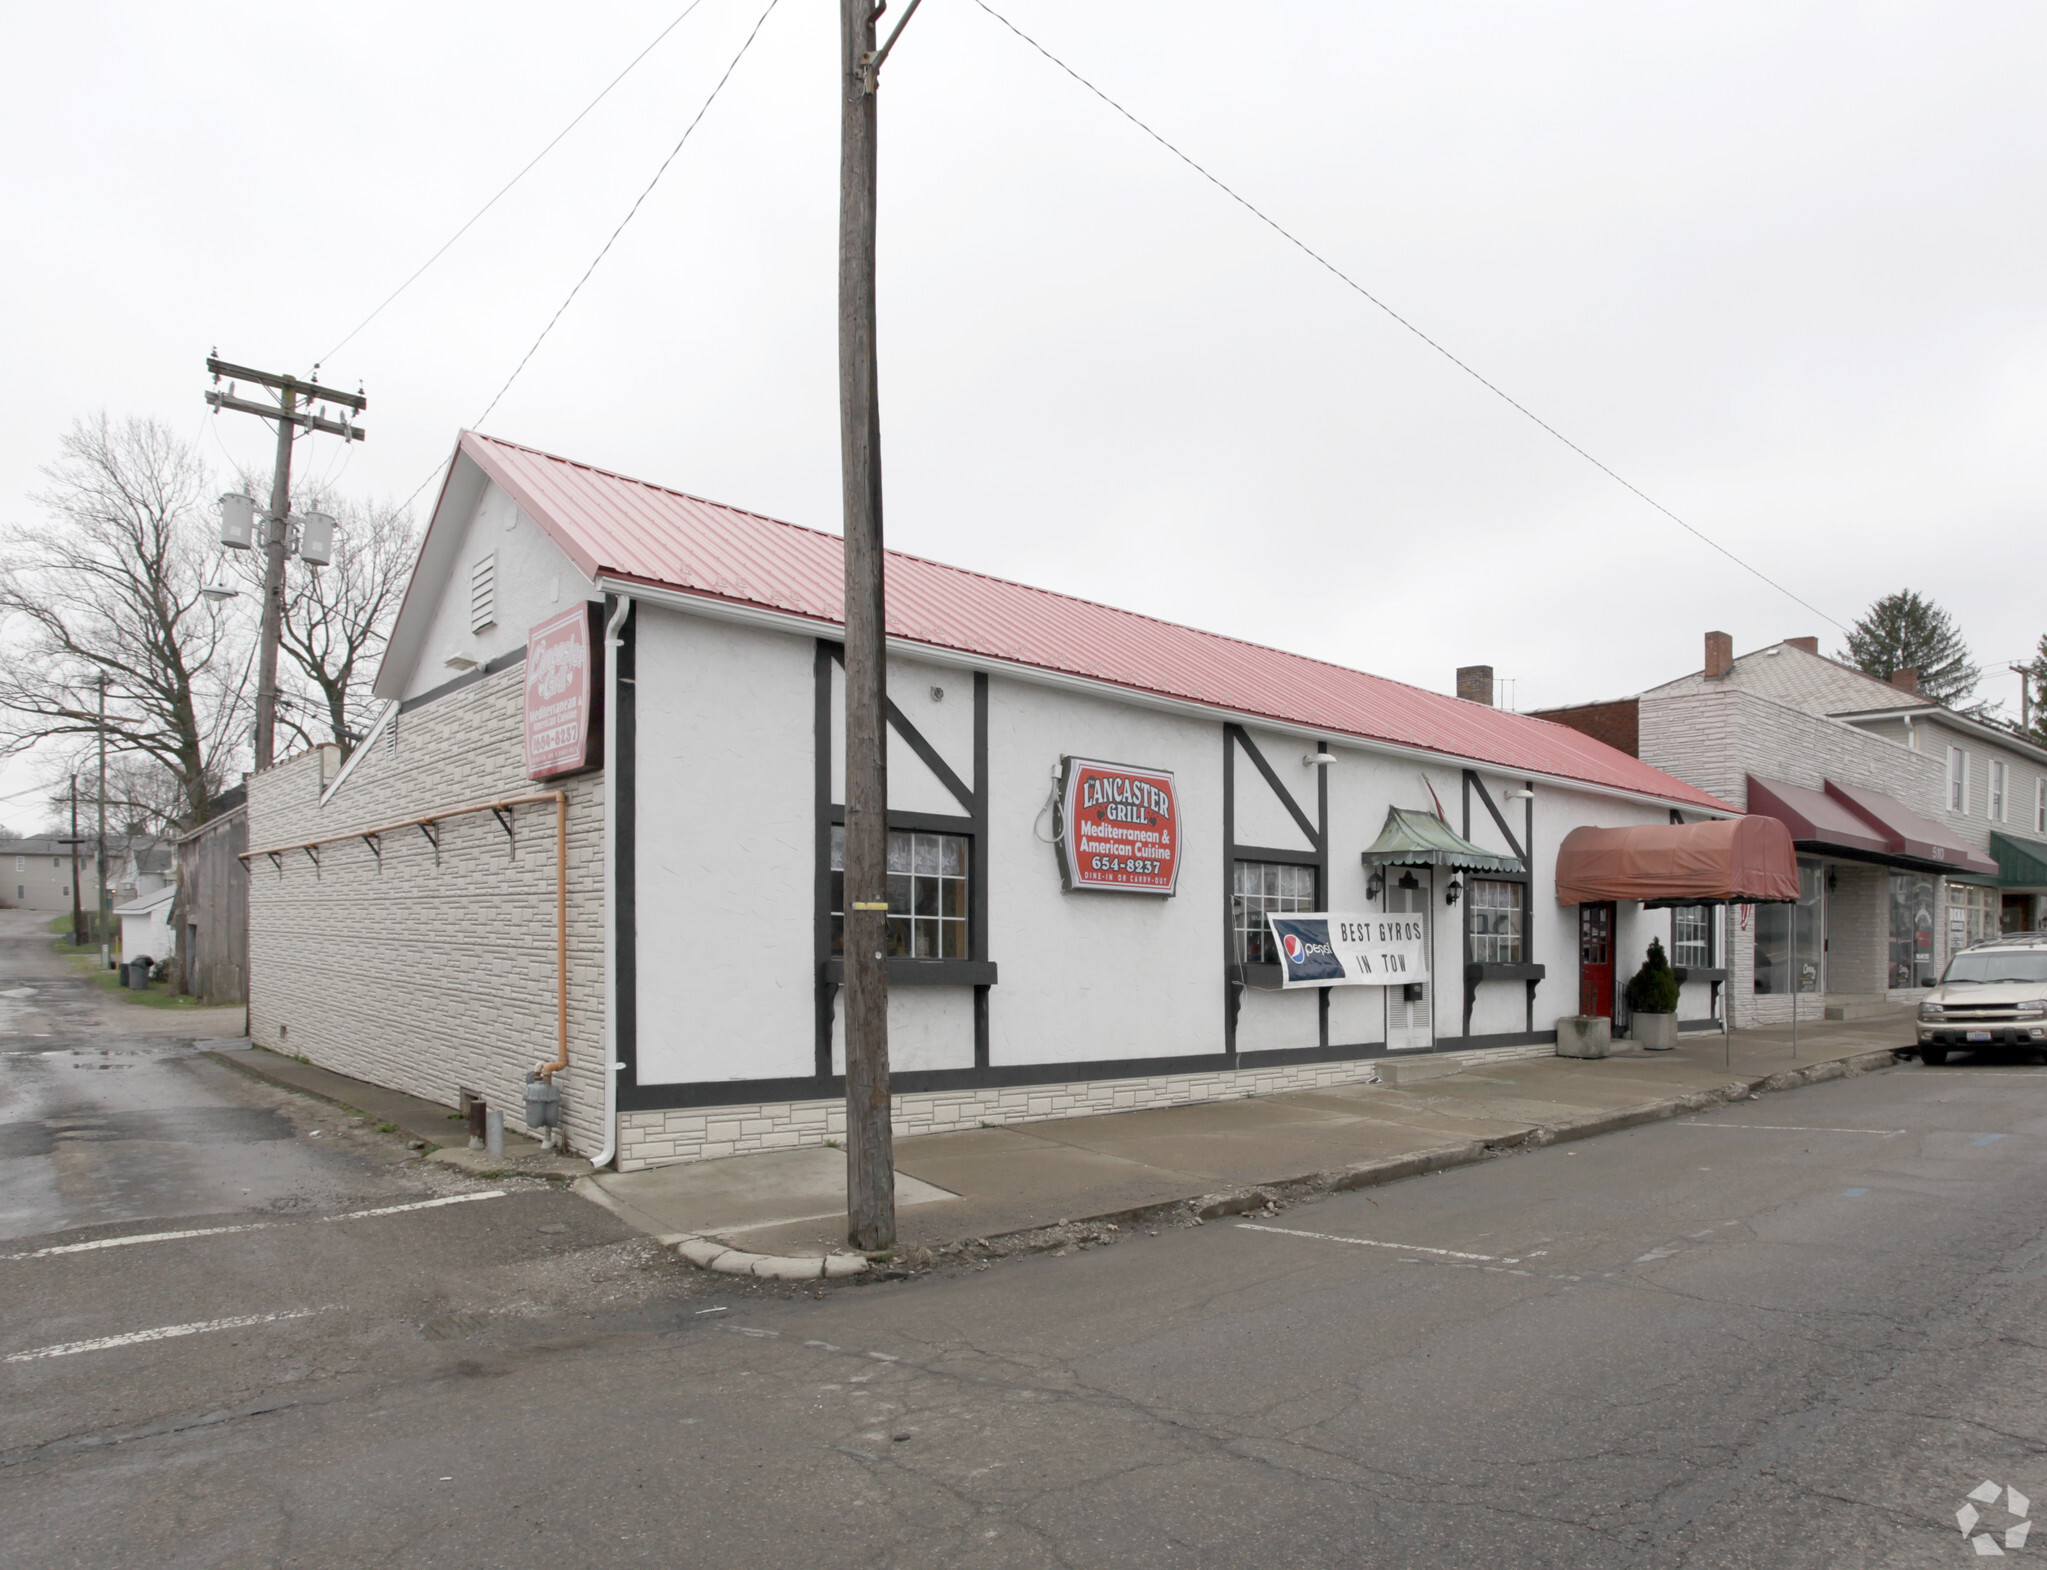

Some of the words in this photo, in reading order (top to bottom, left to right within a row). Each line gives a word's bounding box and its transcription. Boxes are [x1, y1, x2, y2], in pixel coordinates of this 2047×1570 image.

[1083, 777, 1170, 819] LANCASTER
[1106, 803, 1148, 825] GRILL
[1081, 820, 1159, 843] Mediterranean
[1161, 829, 1170, 844] &
[1080, 836, 1132, 856] American
[1134, 843, 1170, 860] Cuisine
[1931, 846, 1945, 860] 510
[1091, 855, 1160, 875] 654-8237
[1085, 872, 1113, 881] DINE-IN
[1117, 874, 1127, 882] OR
[1130, 875, 1167, 885] CARRY-OUT
[1340, 922, 1371, 942] BEST
[1379, 922, 1422, 942] GYROS
[1304, 942, 1333, 957] pepsi
[1356, 955, 1372, 974] IN
[1382, 954, 1406, 972] TOW
